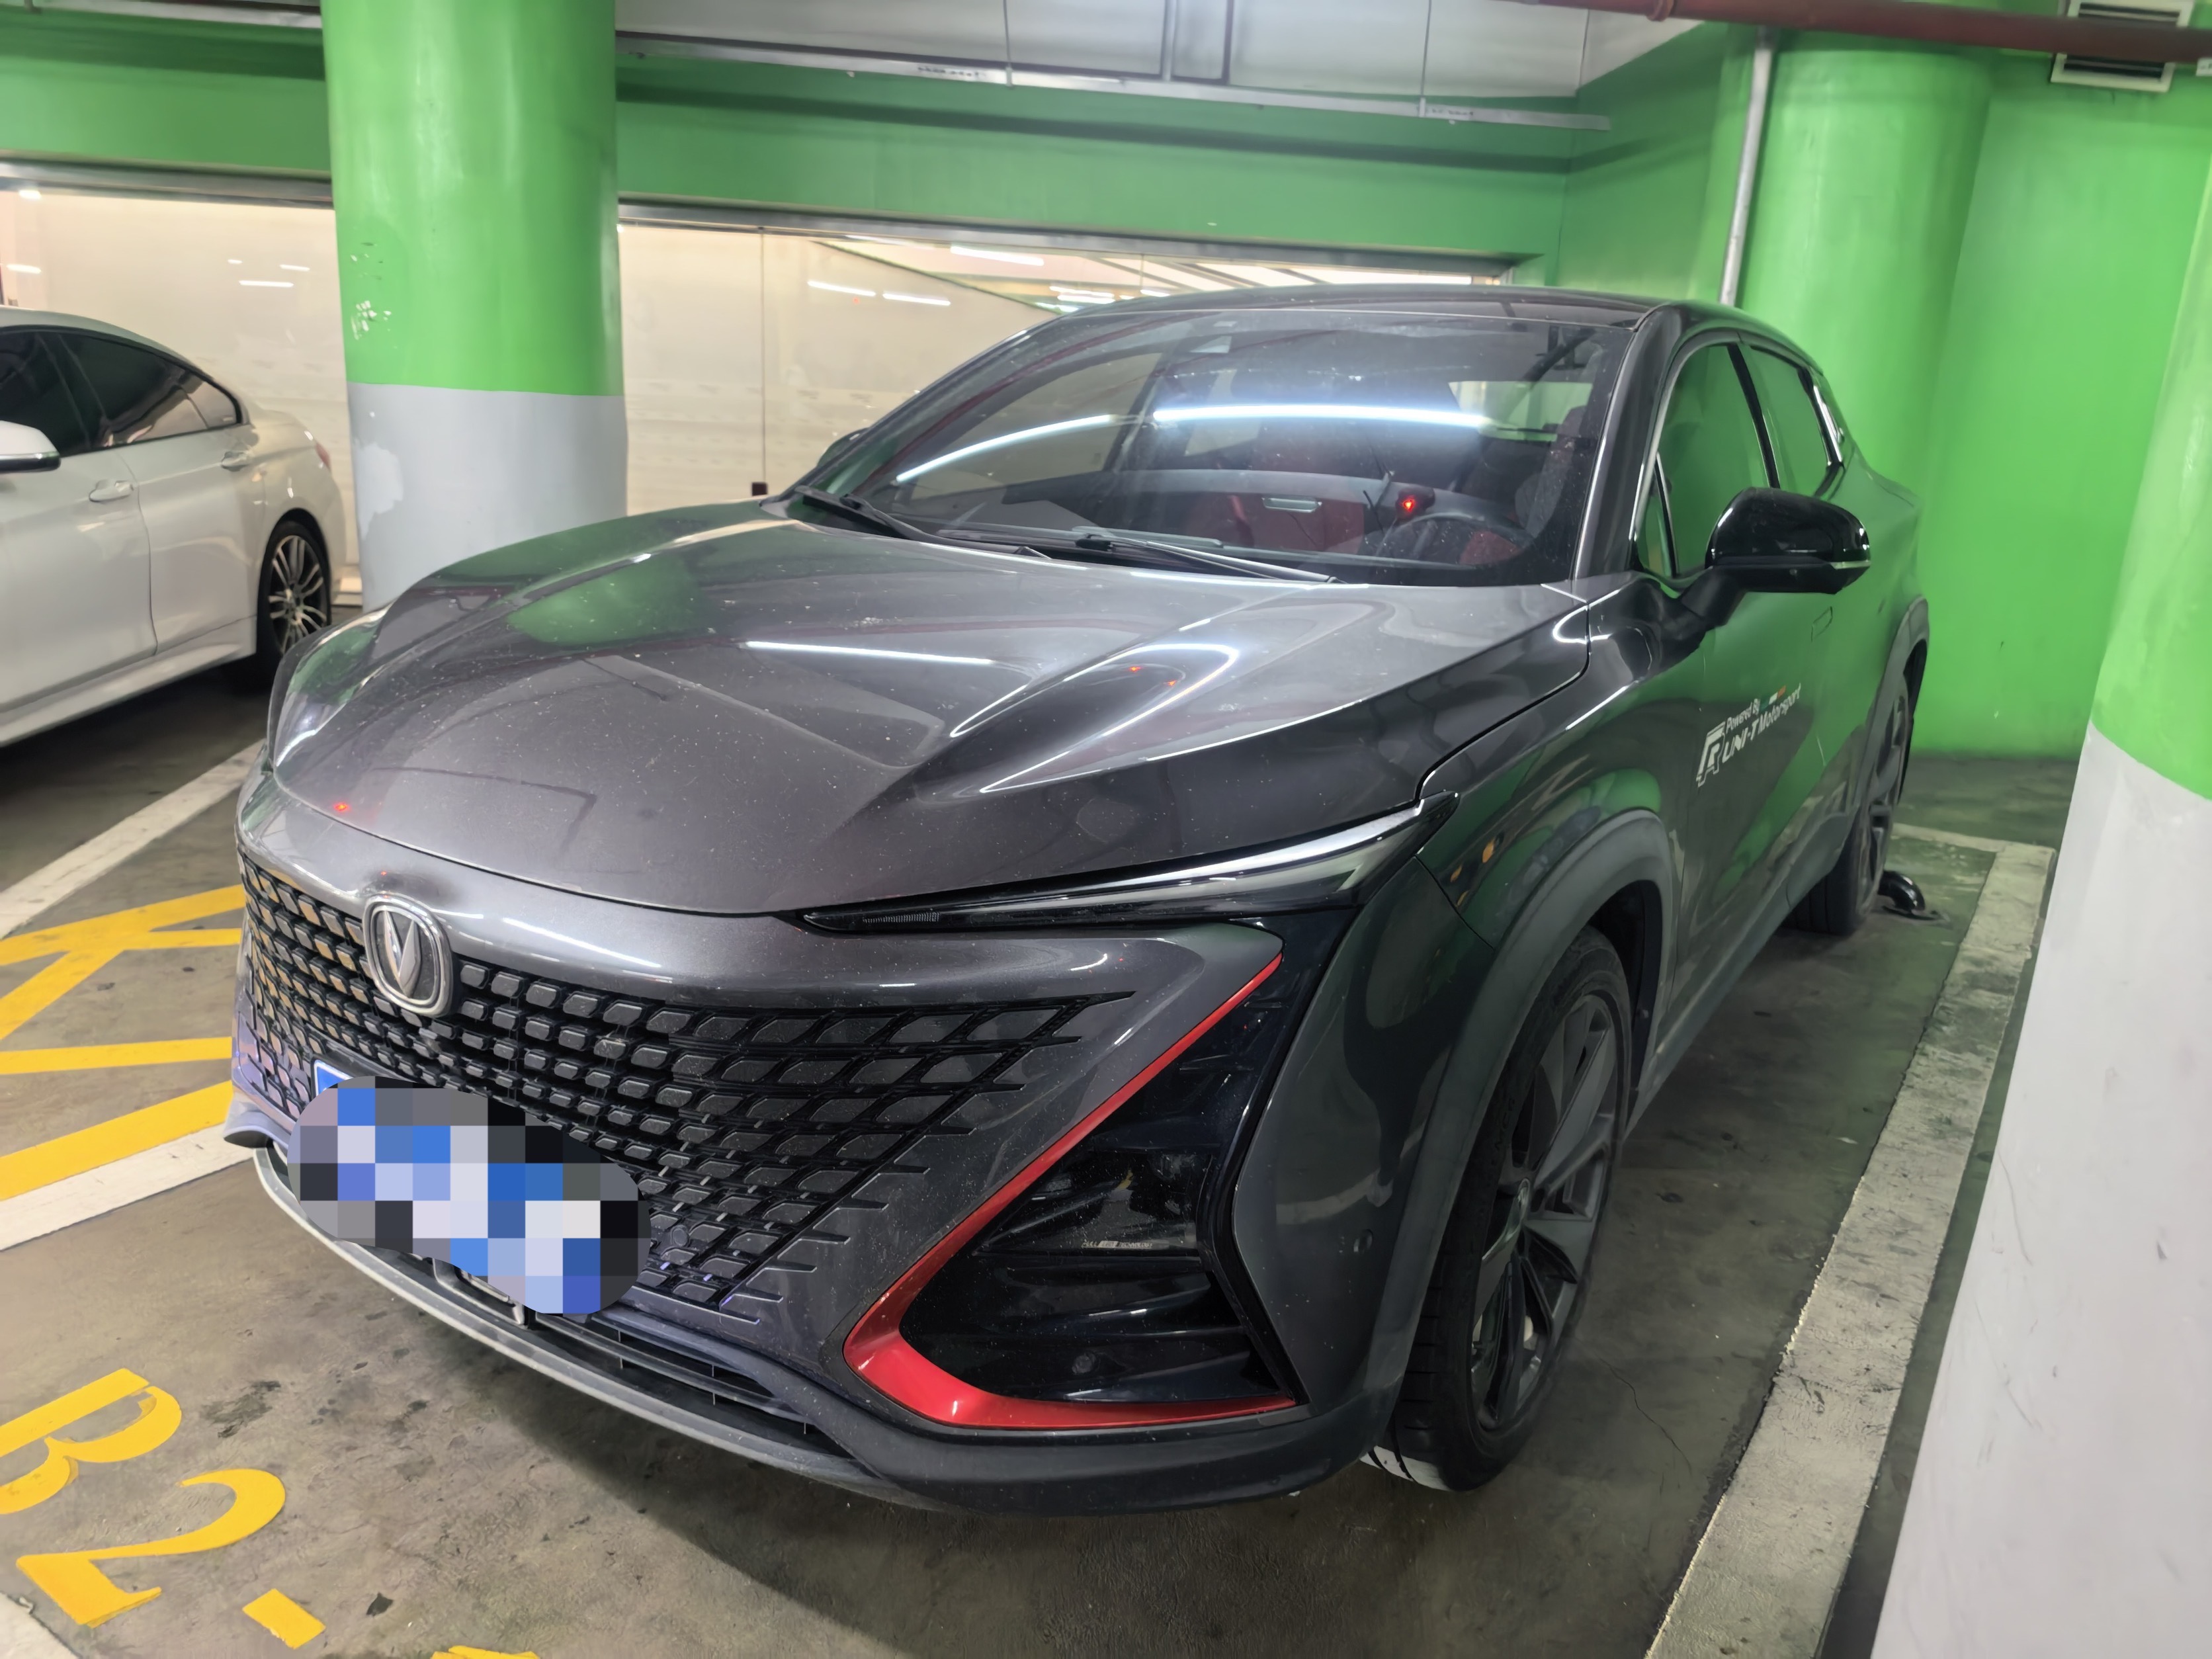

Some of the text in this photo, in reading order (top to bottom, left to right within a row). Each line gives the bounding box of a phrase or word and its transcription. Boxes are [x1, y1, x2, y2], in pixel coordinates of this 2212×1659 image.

[1722, 683, 1801, 763] UNI-T Motorsport
[1726, 702, 1753, 734] Powered
